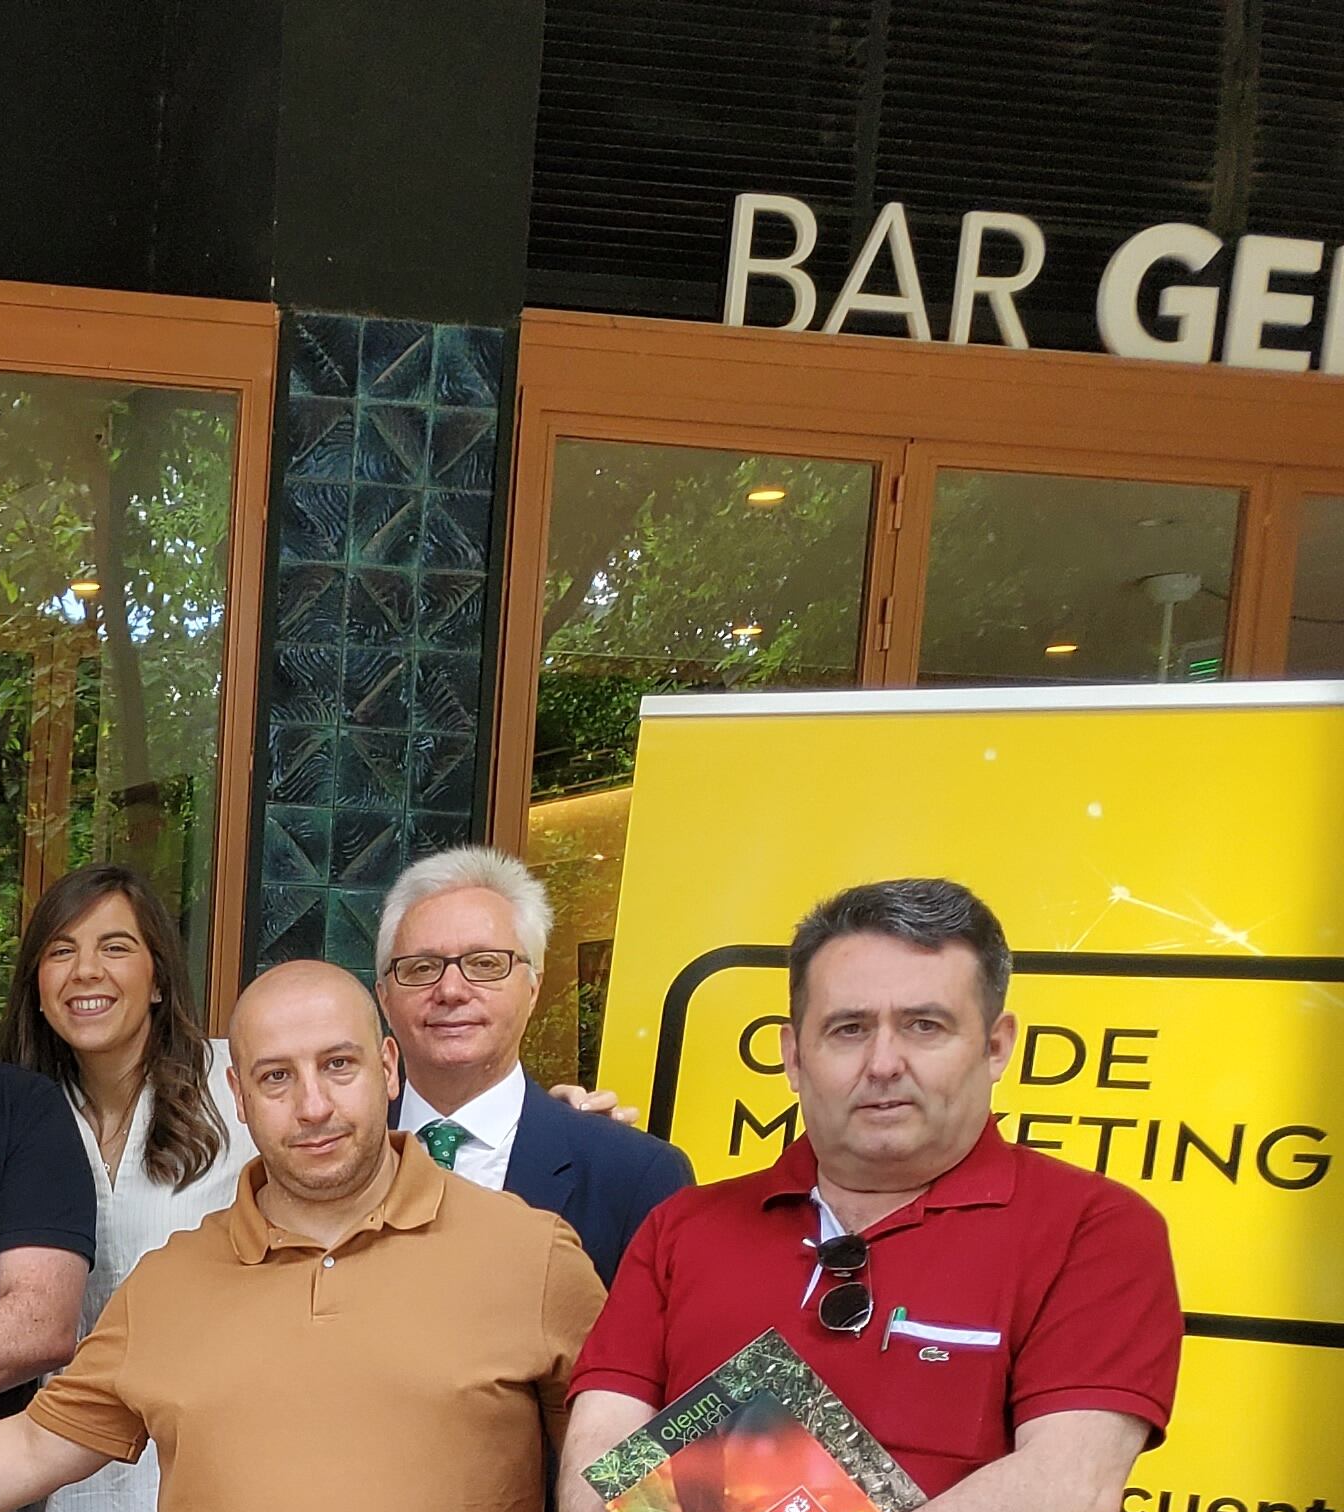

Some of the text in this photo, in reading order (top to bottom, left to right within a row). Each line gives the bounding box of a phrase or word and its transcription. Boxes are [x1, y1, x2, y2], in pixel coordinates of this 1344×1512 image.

[722, 193, 1344, 375] BAR GE
[1020, 1025, 1159, 1090] DE
[661, 1393, 721, 1440] oleum
